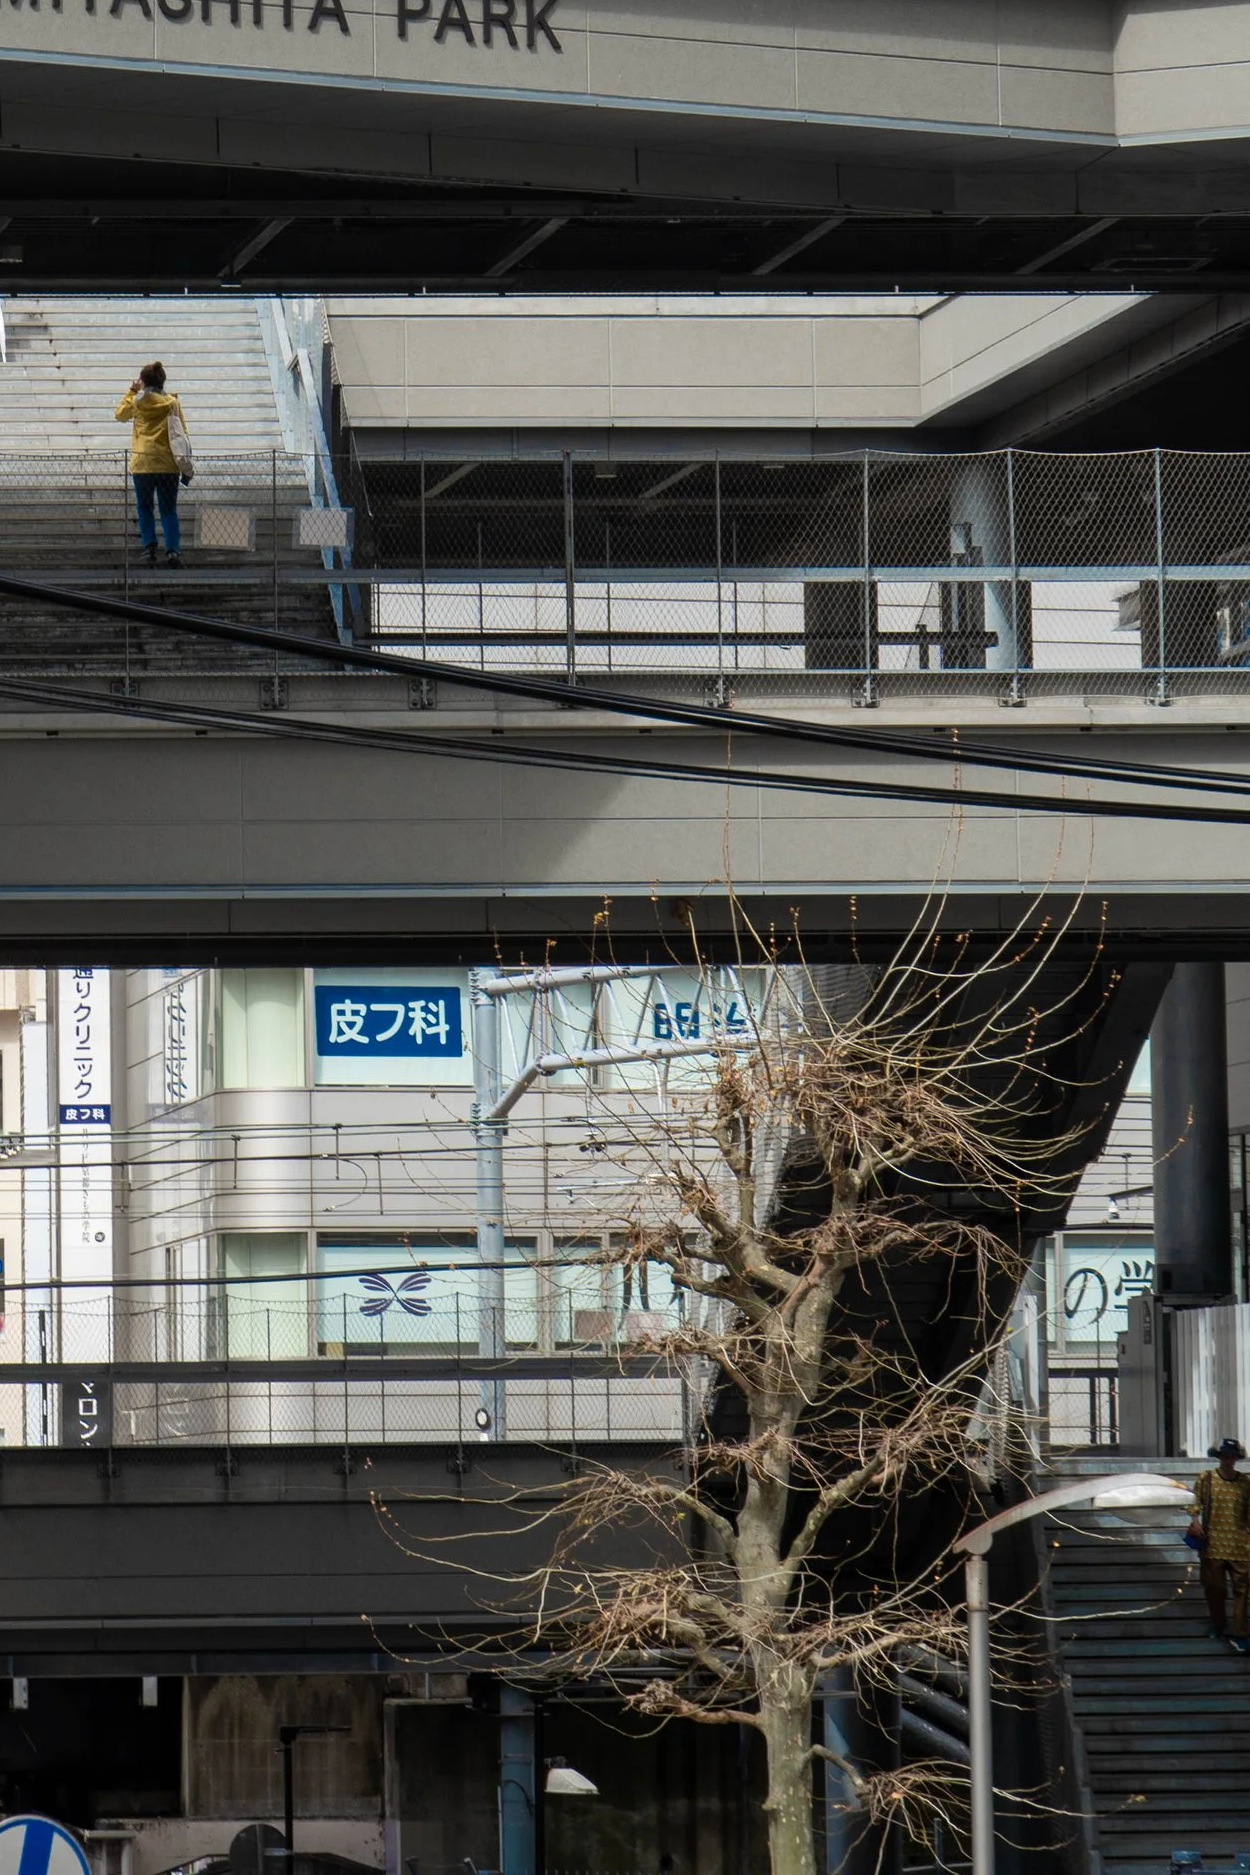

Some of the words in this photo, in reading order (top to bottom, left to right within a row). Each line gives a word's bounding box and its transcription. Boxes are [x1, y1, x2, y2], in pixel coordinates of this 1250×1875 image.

[330, 998, 450, 1045] 皮フ科
[65, 1108, 105, 1121] 皮フ科
